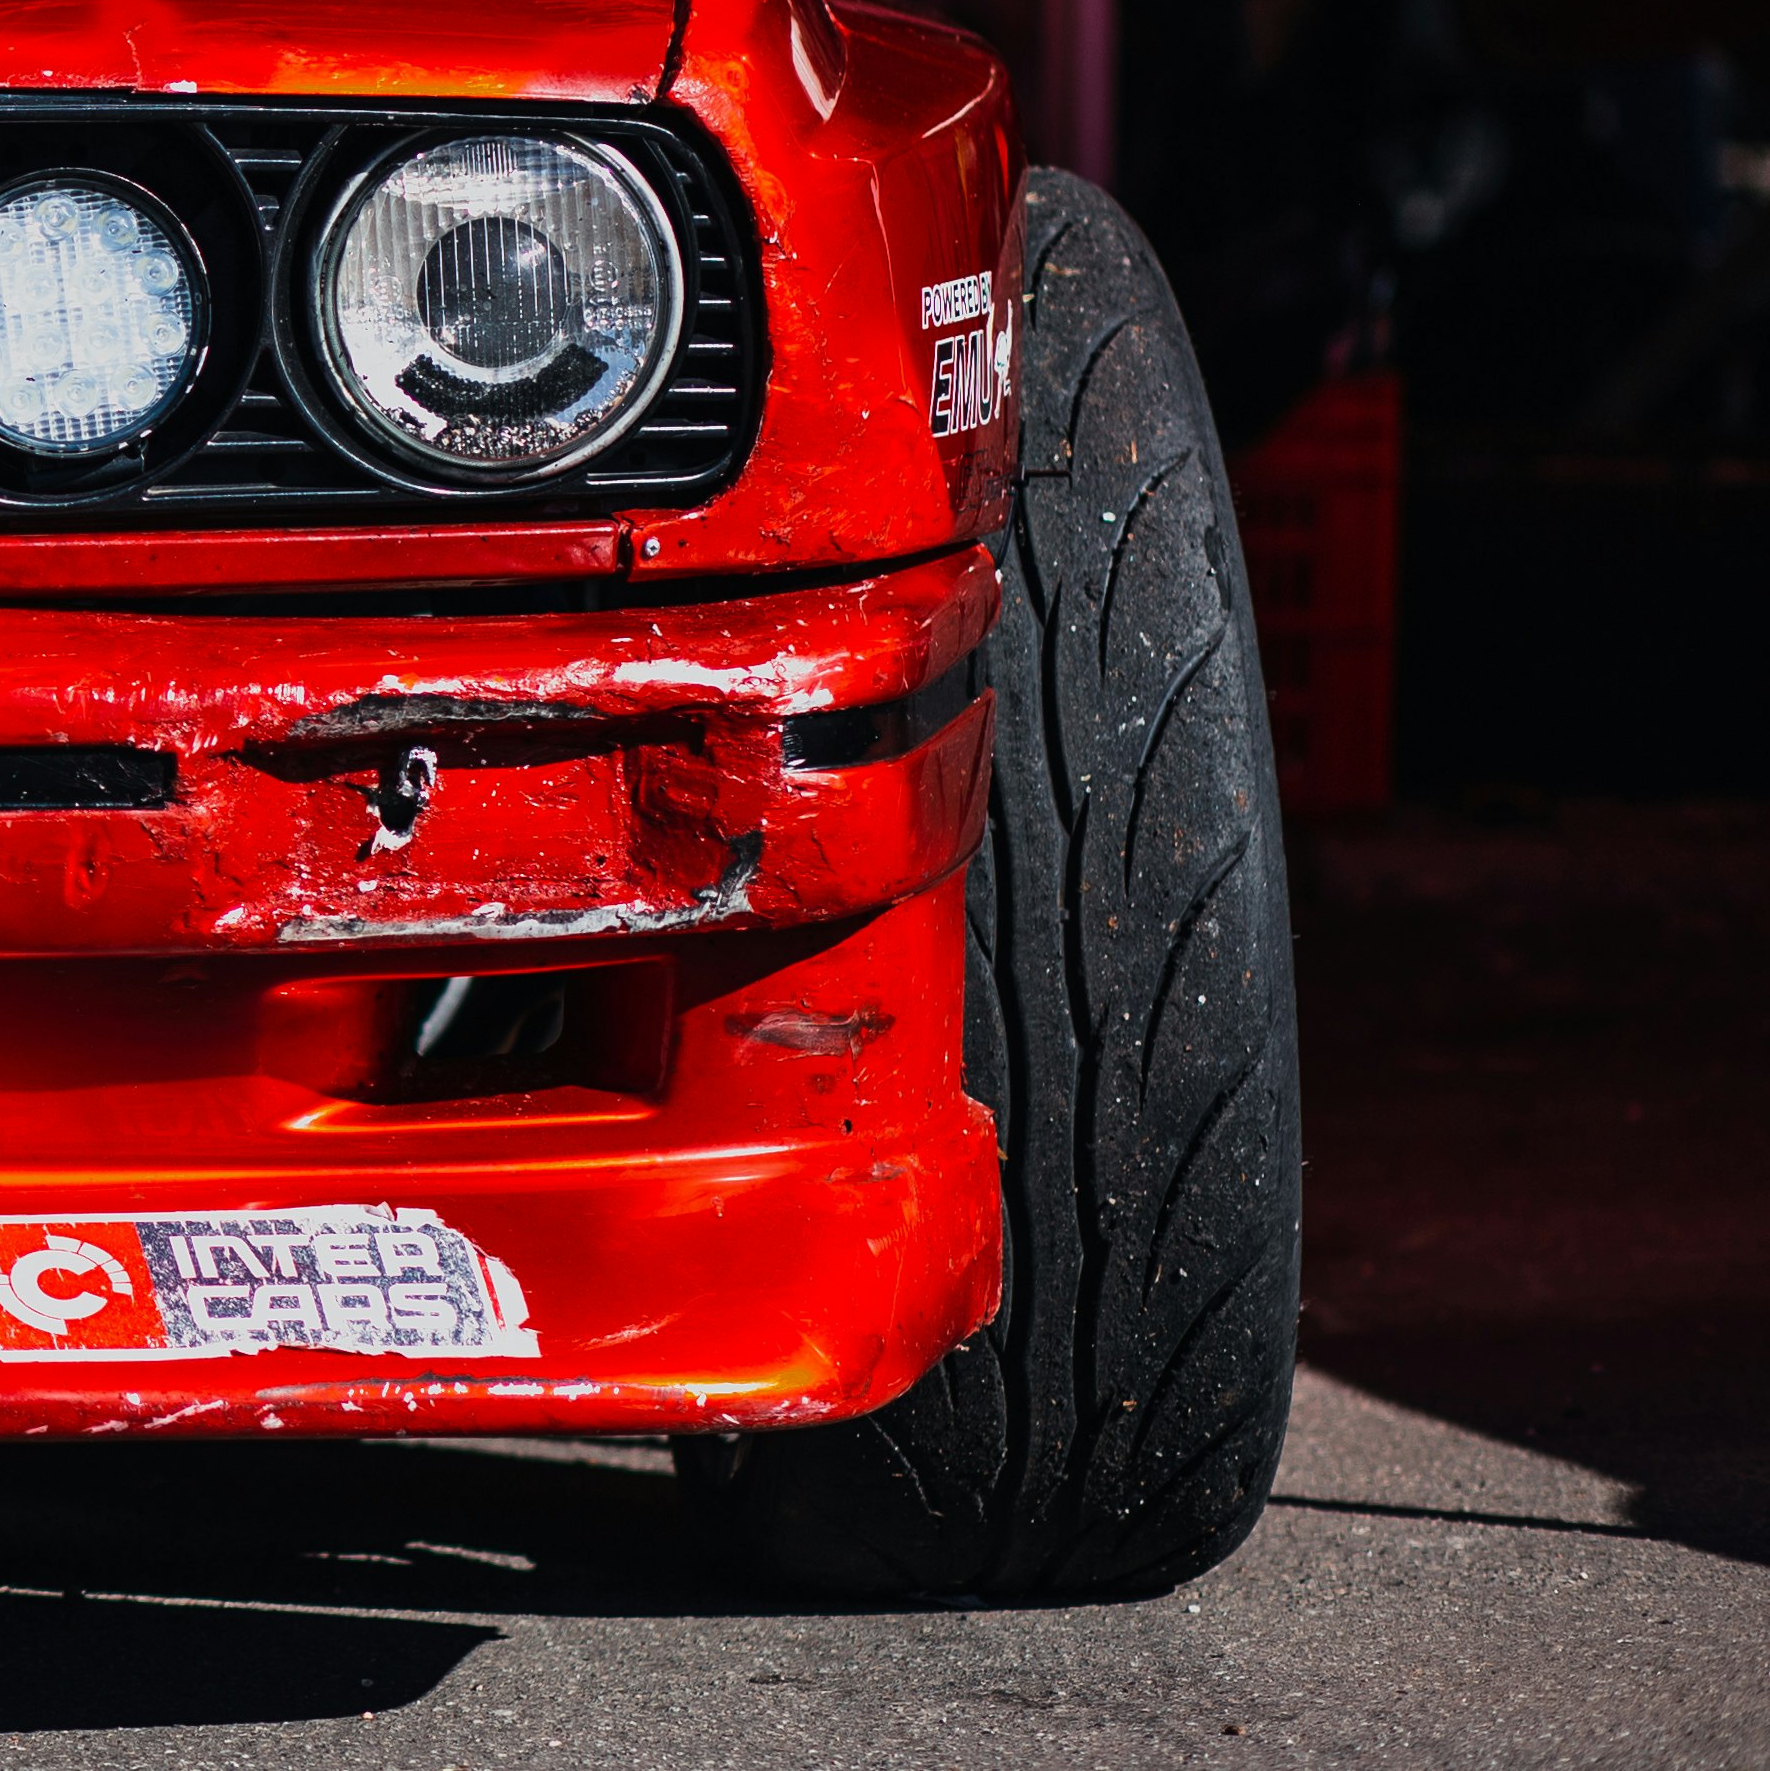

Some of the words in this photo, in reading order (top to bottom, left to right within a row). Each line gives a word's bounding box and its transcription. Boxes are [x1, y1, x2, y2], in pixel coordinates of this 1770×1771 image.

[921, 278, 979, 329] POWERED
[929, 330, 994, 438] EMU
[167, 1230, 443, 1278] INTER
[184, 1282, 457, 1330] CARS
